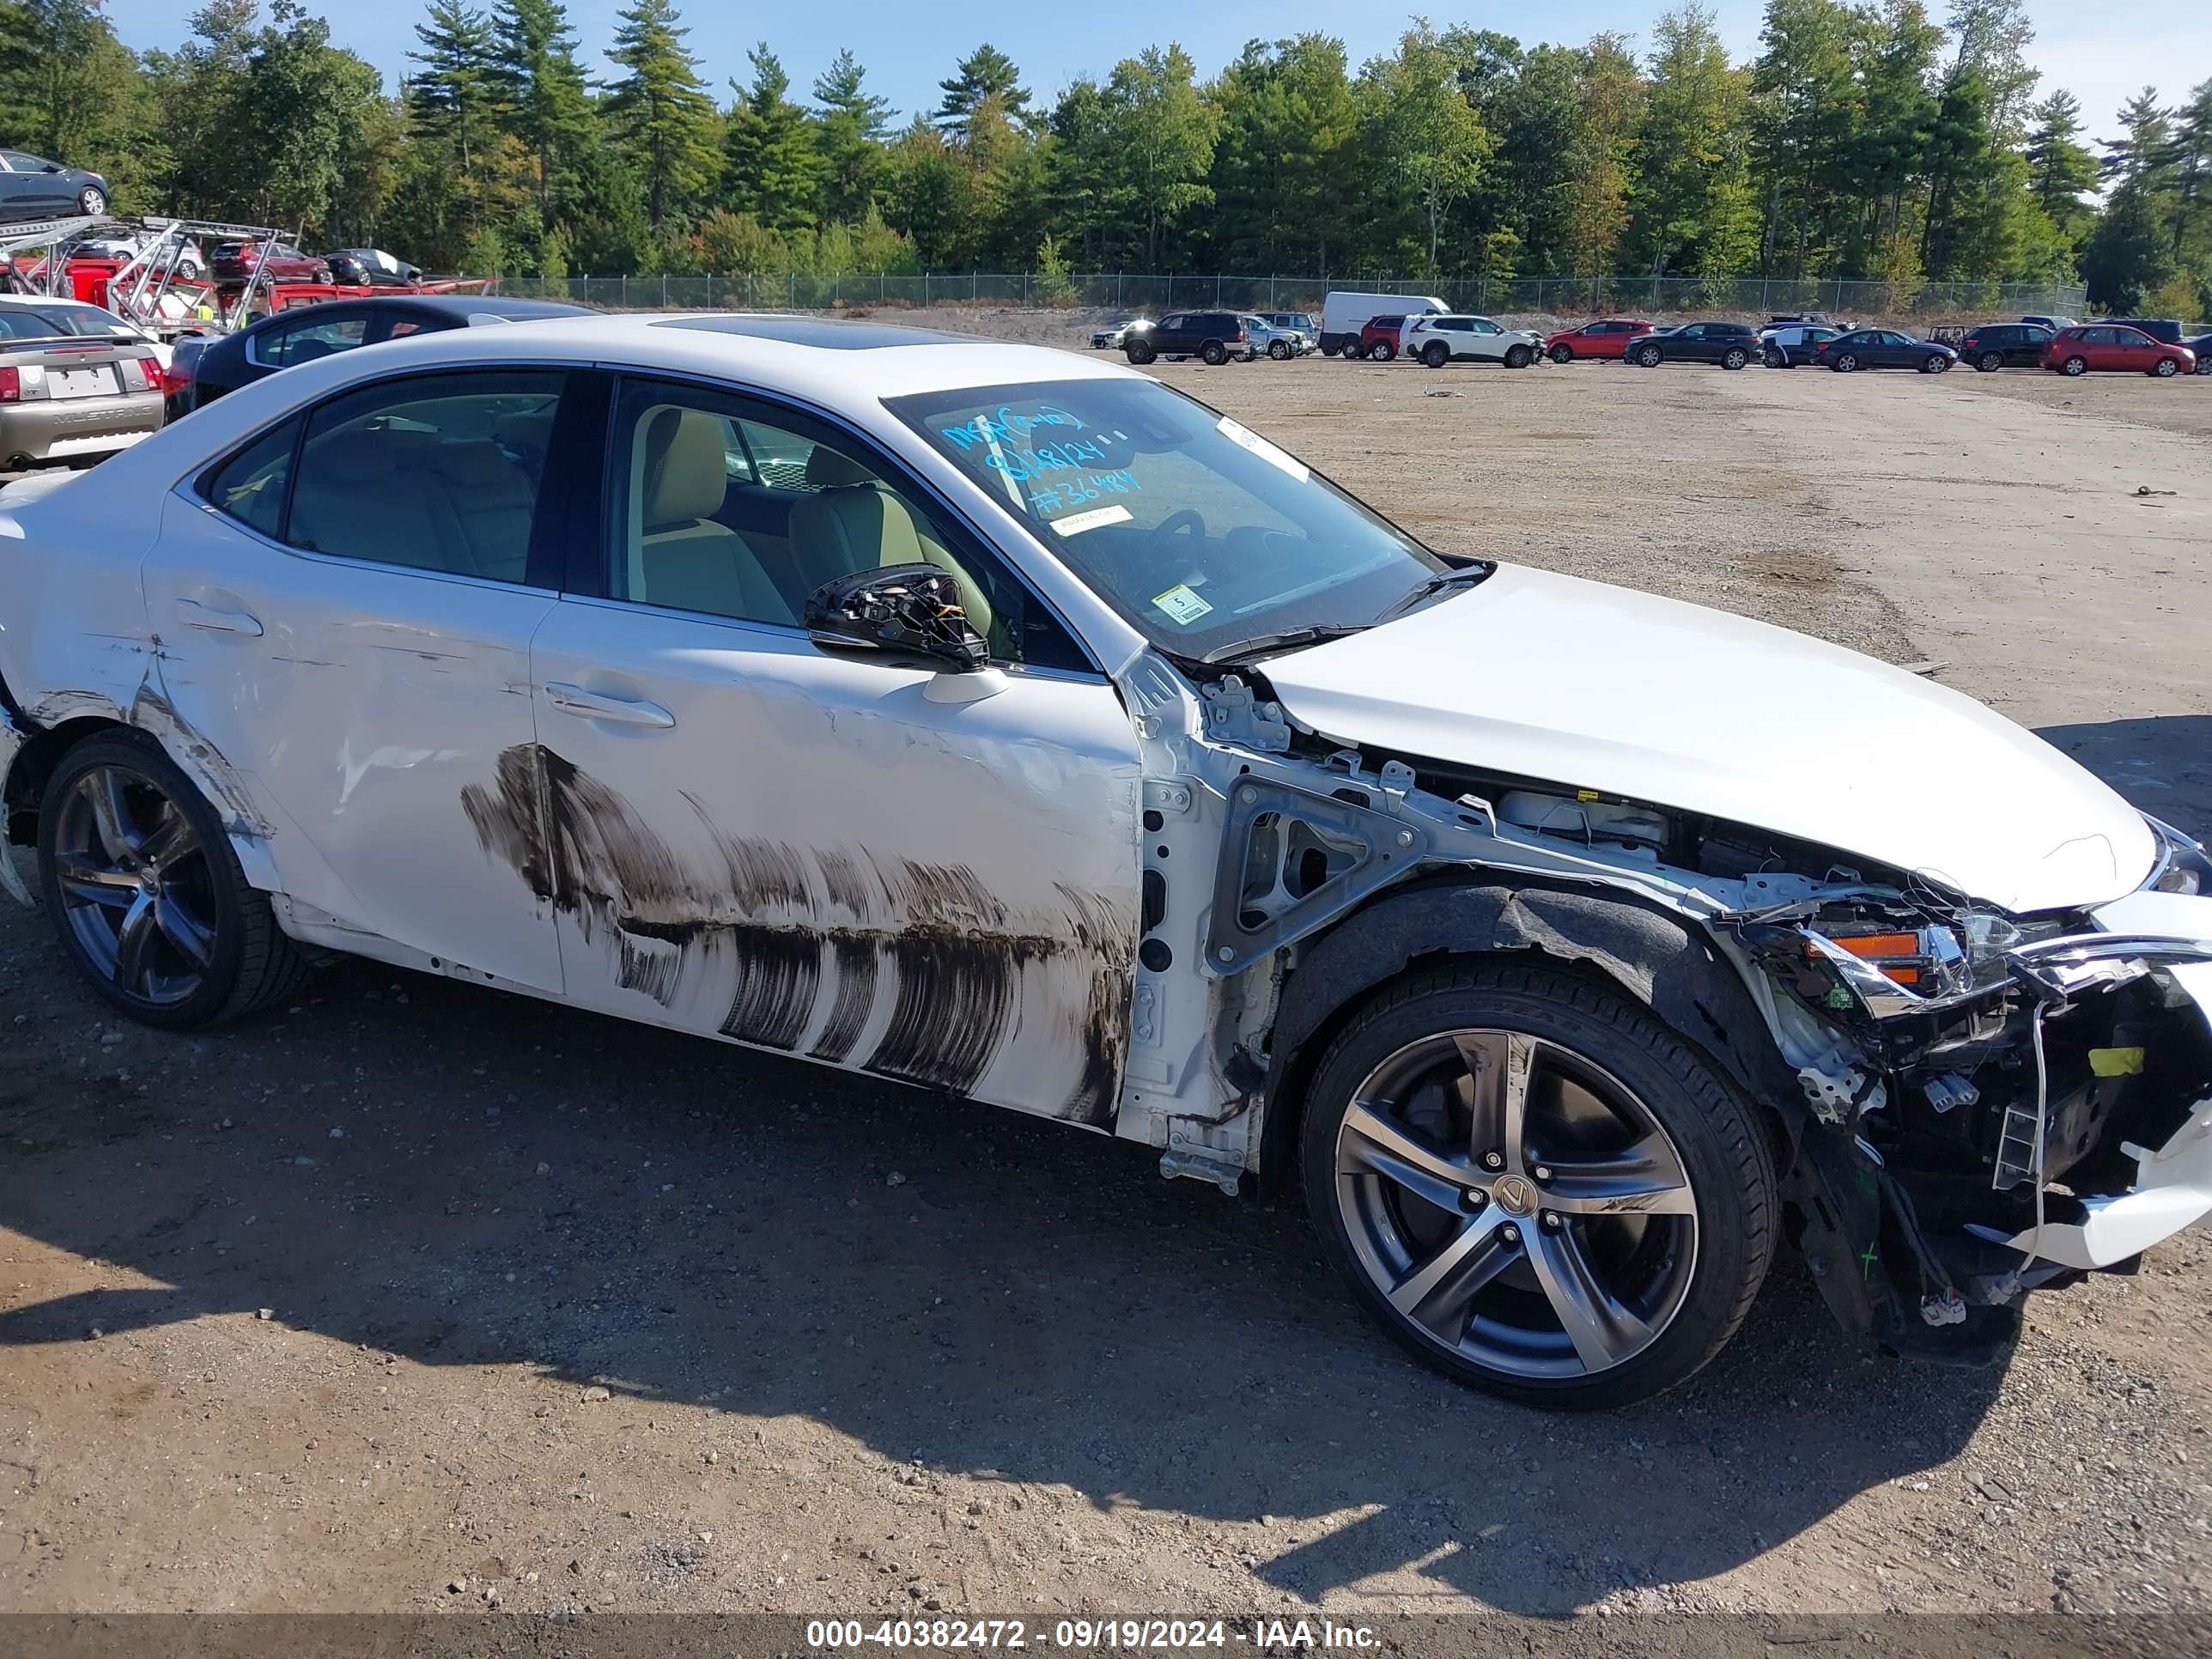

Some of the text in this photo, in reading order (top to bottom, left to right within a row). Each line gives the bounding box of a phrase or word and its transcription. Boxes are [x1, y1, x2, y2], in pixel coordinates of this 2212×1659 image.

[53, 405, 152, 424] MUSTANG
[985, 439, 1105, 481] 8/28/24
[1174, 597, 1186, 607] 5
